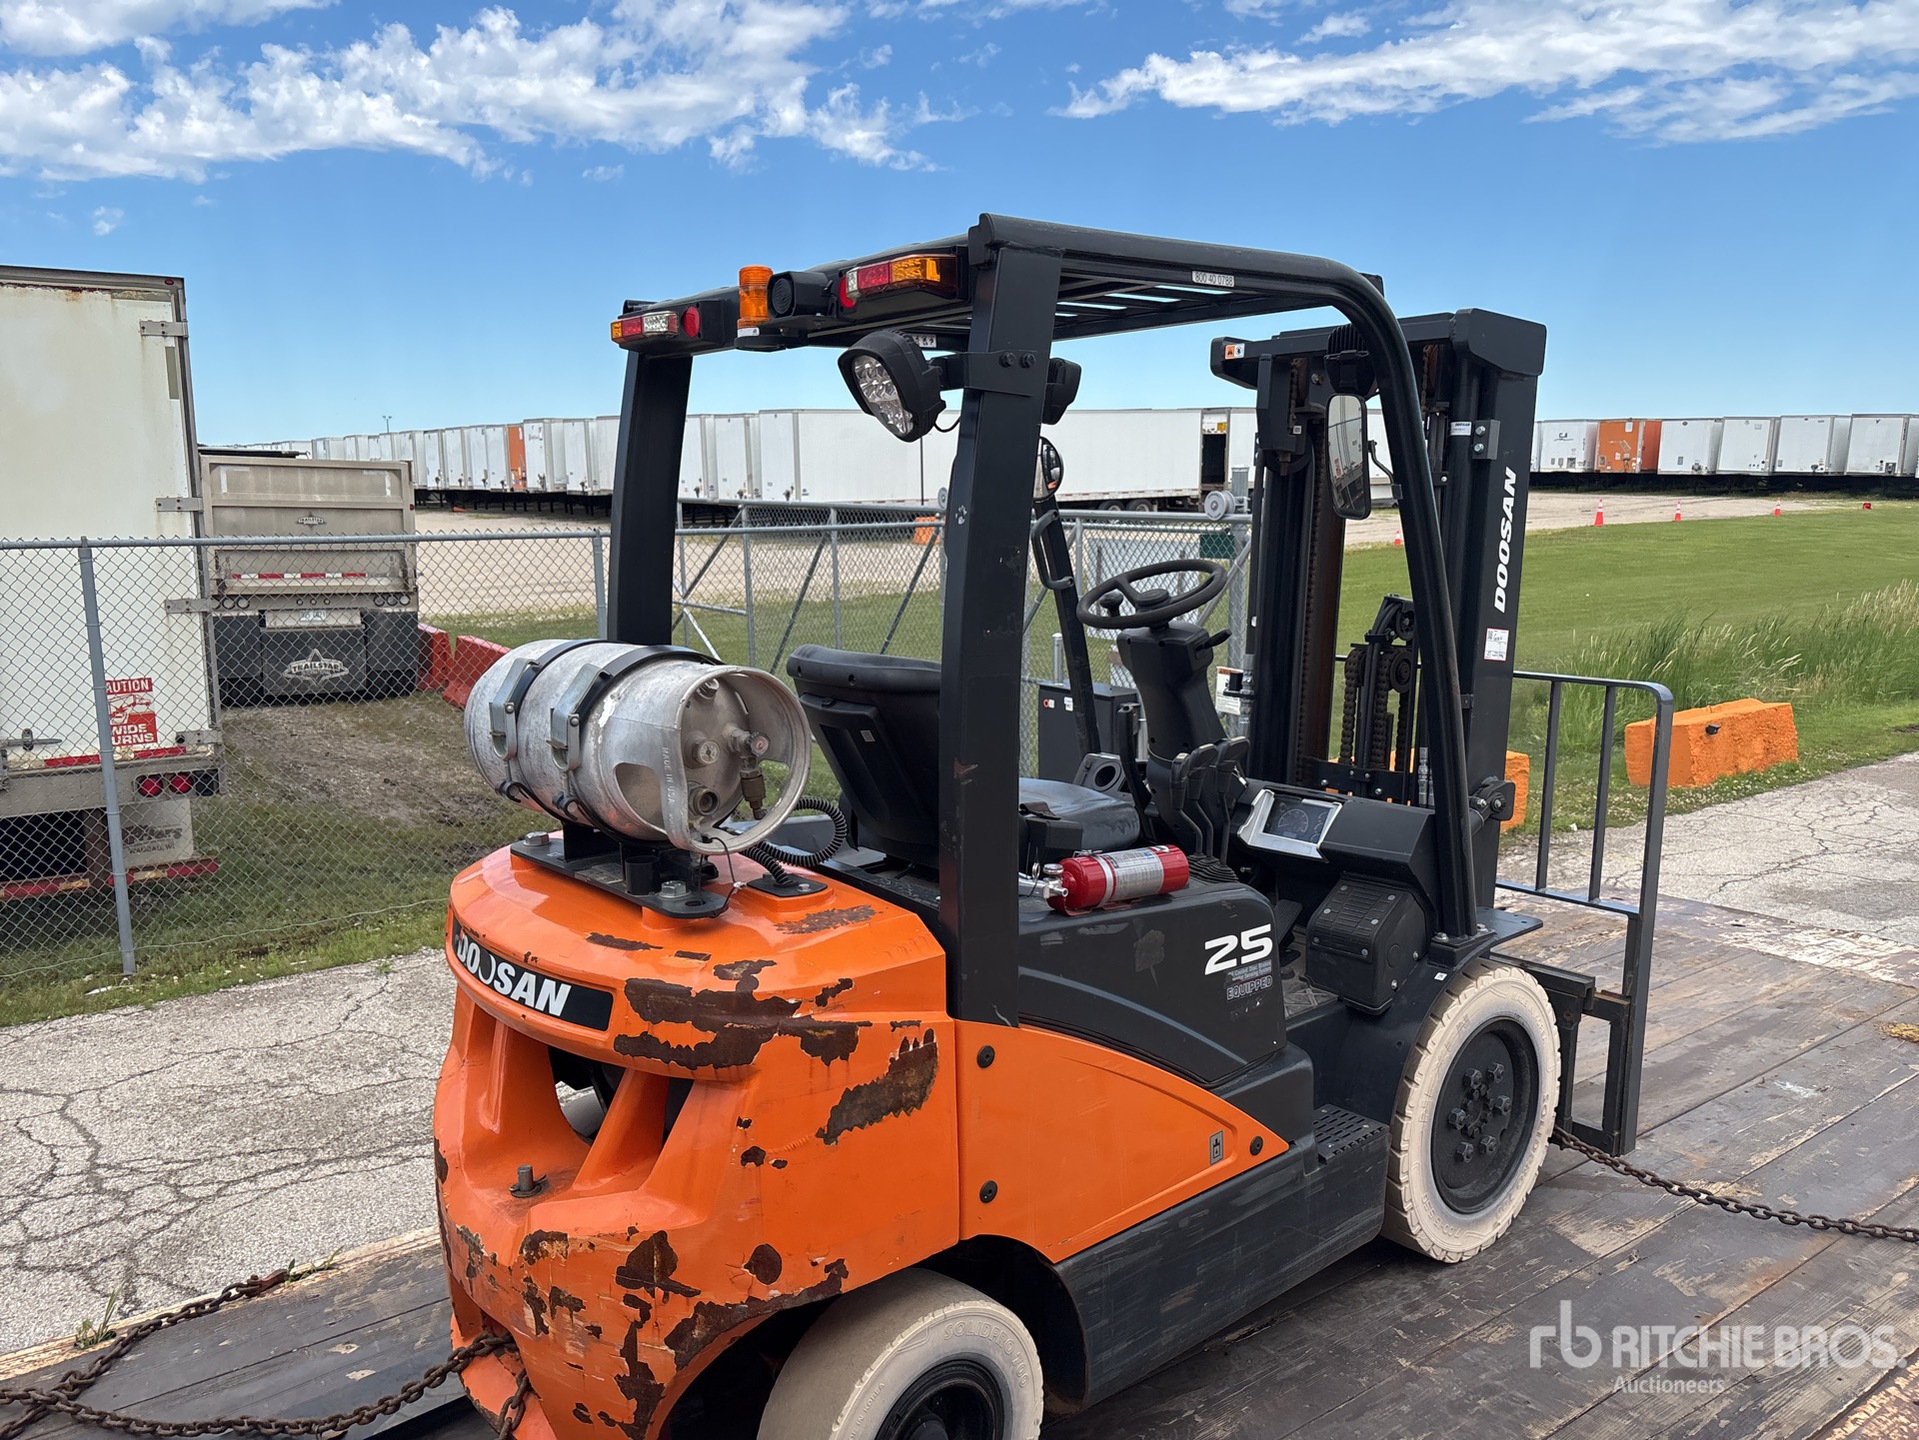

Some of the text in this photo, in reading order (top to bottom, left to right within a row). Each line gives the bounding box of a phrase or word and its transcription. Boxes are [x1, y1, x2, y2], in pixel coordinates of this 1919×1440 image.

[1494, 466, 1517, 613] DOOSAN
[106, 679, 150, 693] AUTION
[112, 732, 154, 746] URNS
[1204, 923, 1273, 975] 25
[1226, 975, 1273, 1000] EQUIPPED
[943, 1319, 1015, 1356] SOLIDPRO
[863, 1382, 885, 1413] KOREA
